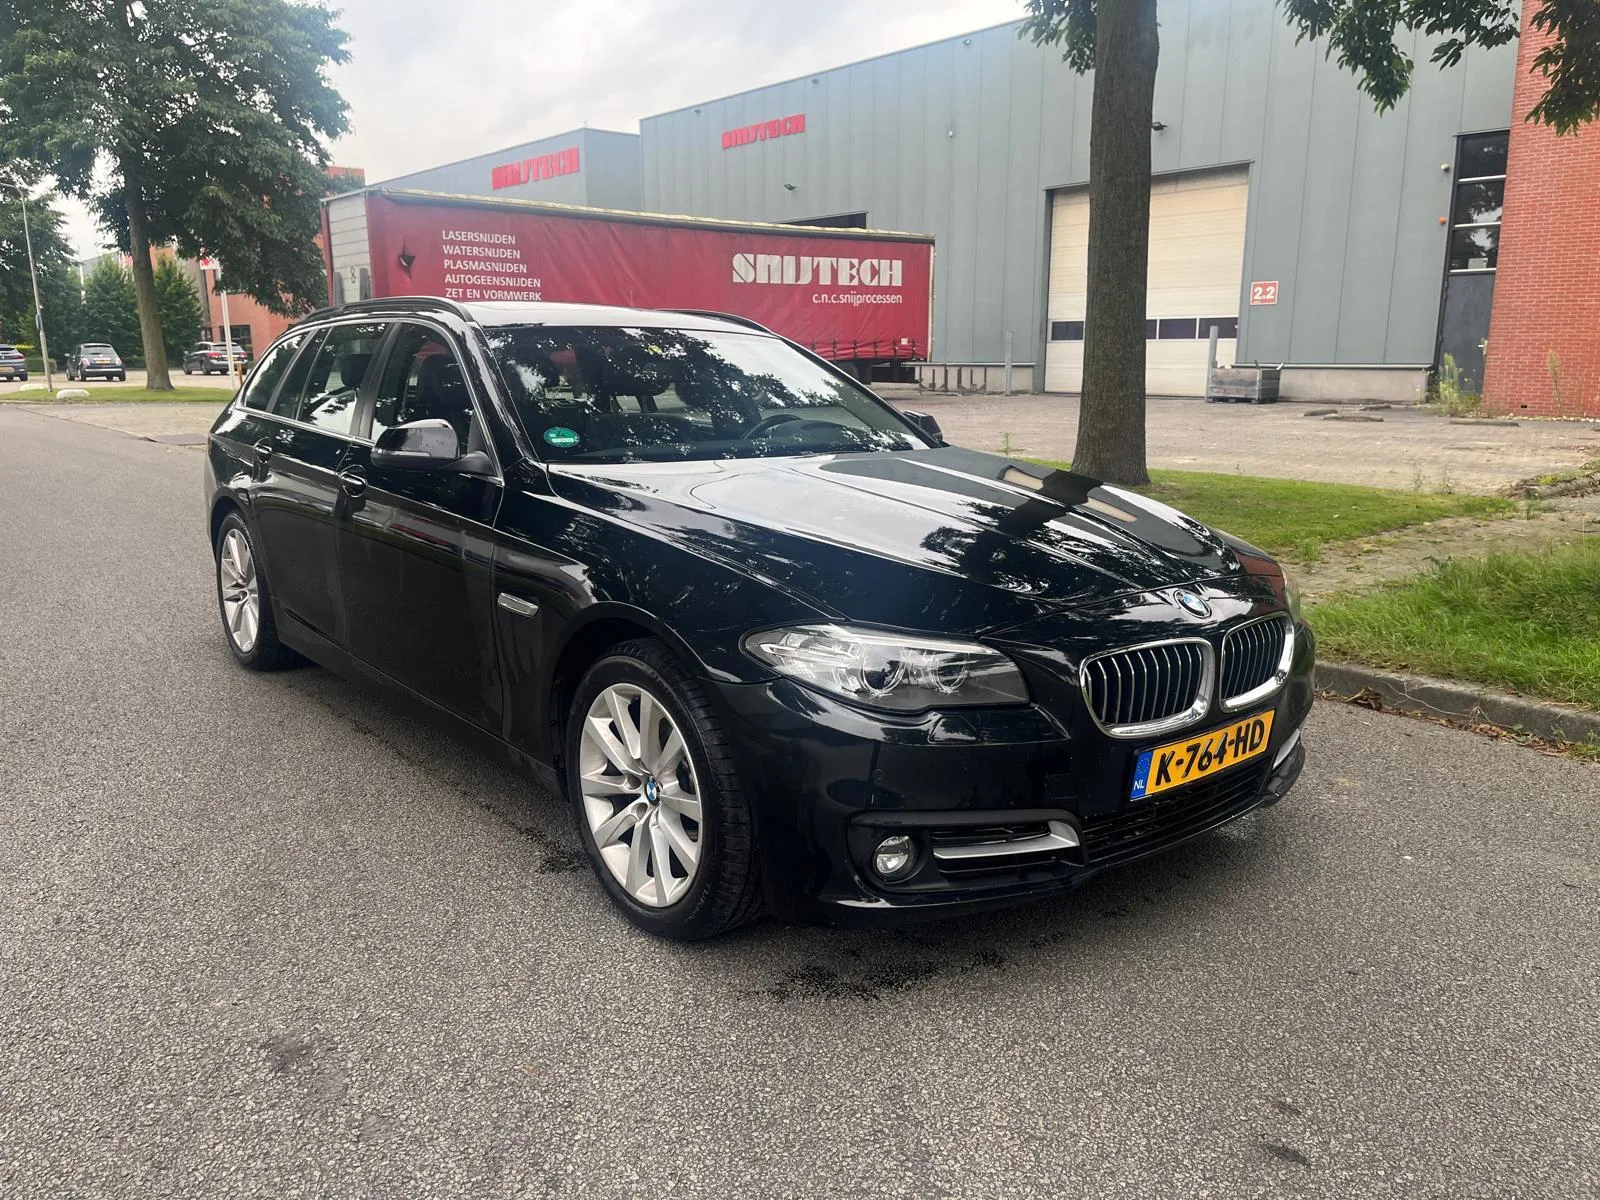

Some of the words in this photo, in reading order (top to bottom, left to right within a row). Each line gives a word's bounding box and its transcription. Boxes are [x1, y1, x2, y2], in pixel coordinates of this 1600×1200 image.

[442, 229, 516, 245] LASERSNIJDEN
[442, 244, 521, 260] WATERSNIJDEN
[443, 259, 528, 274] PLASMASNIJDEN
[444, 273, 541, 288] AUTOGEENSNIJDEN
[445, 287, 464, 298] ZET
[466, 288, 481, 299] EN
[482, 289, 543, 301] VORMWERK
[1253, 286, 1276, 300] 2.2
[1155, 718, 1265, 787] K-764-HD
[1132, 780, 1146, 791] NL
